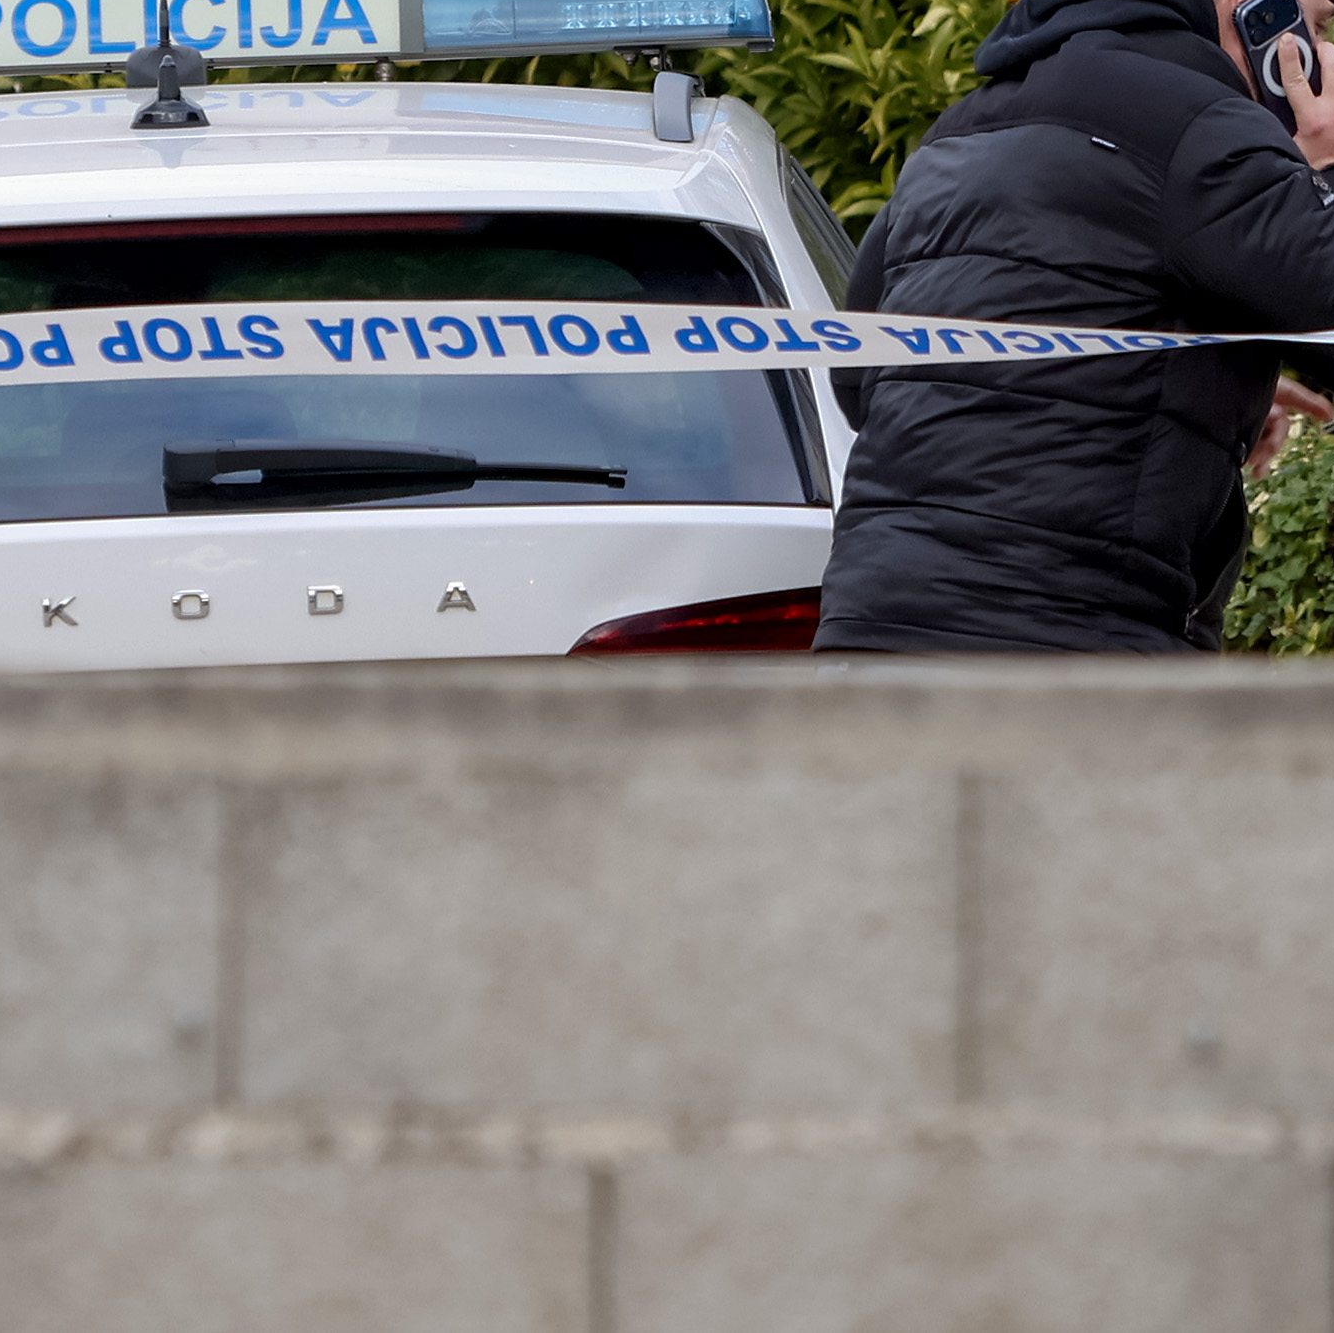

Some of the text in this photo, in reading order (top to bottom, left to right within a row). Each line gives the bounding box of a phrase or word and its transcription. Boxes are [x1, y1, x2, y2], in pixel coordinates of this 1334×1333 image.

[97, 314, 286, 363] STOP
[307, 313, 652, 363] POLICIJA
[674, 314, 862, 354] STOP
